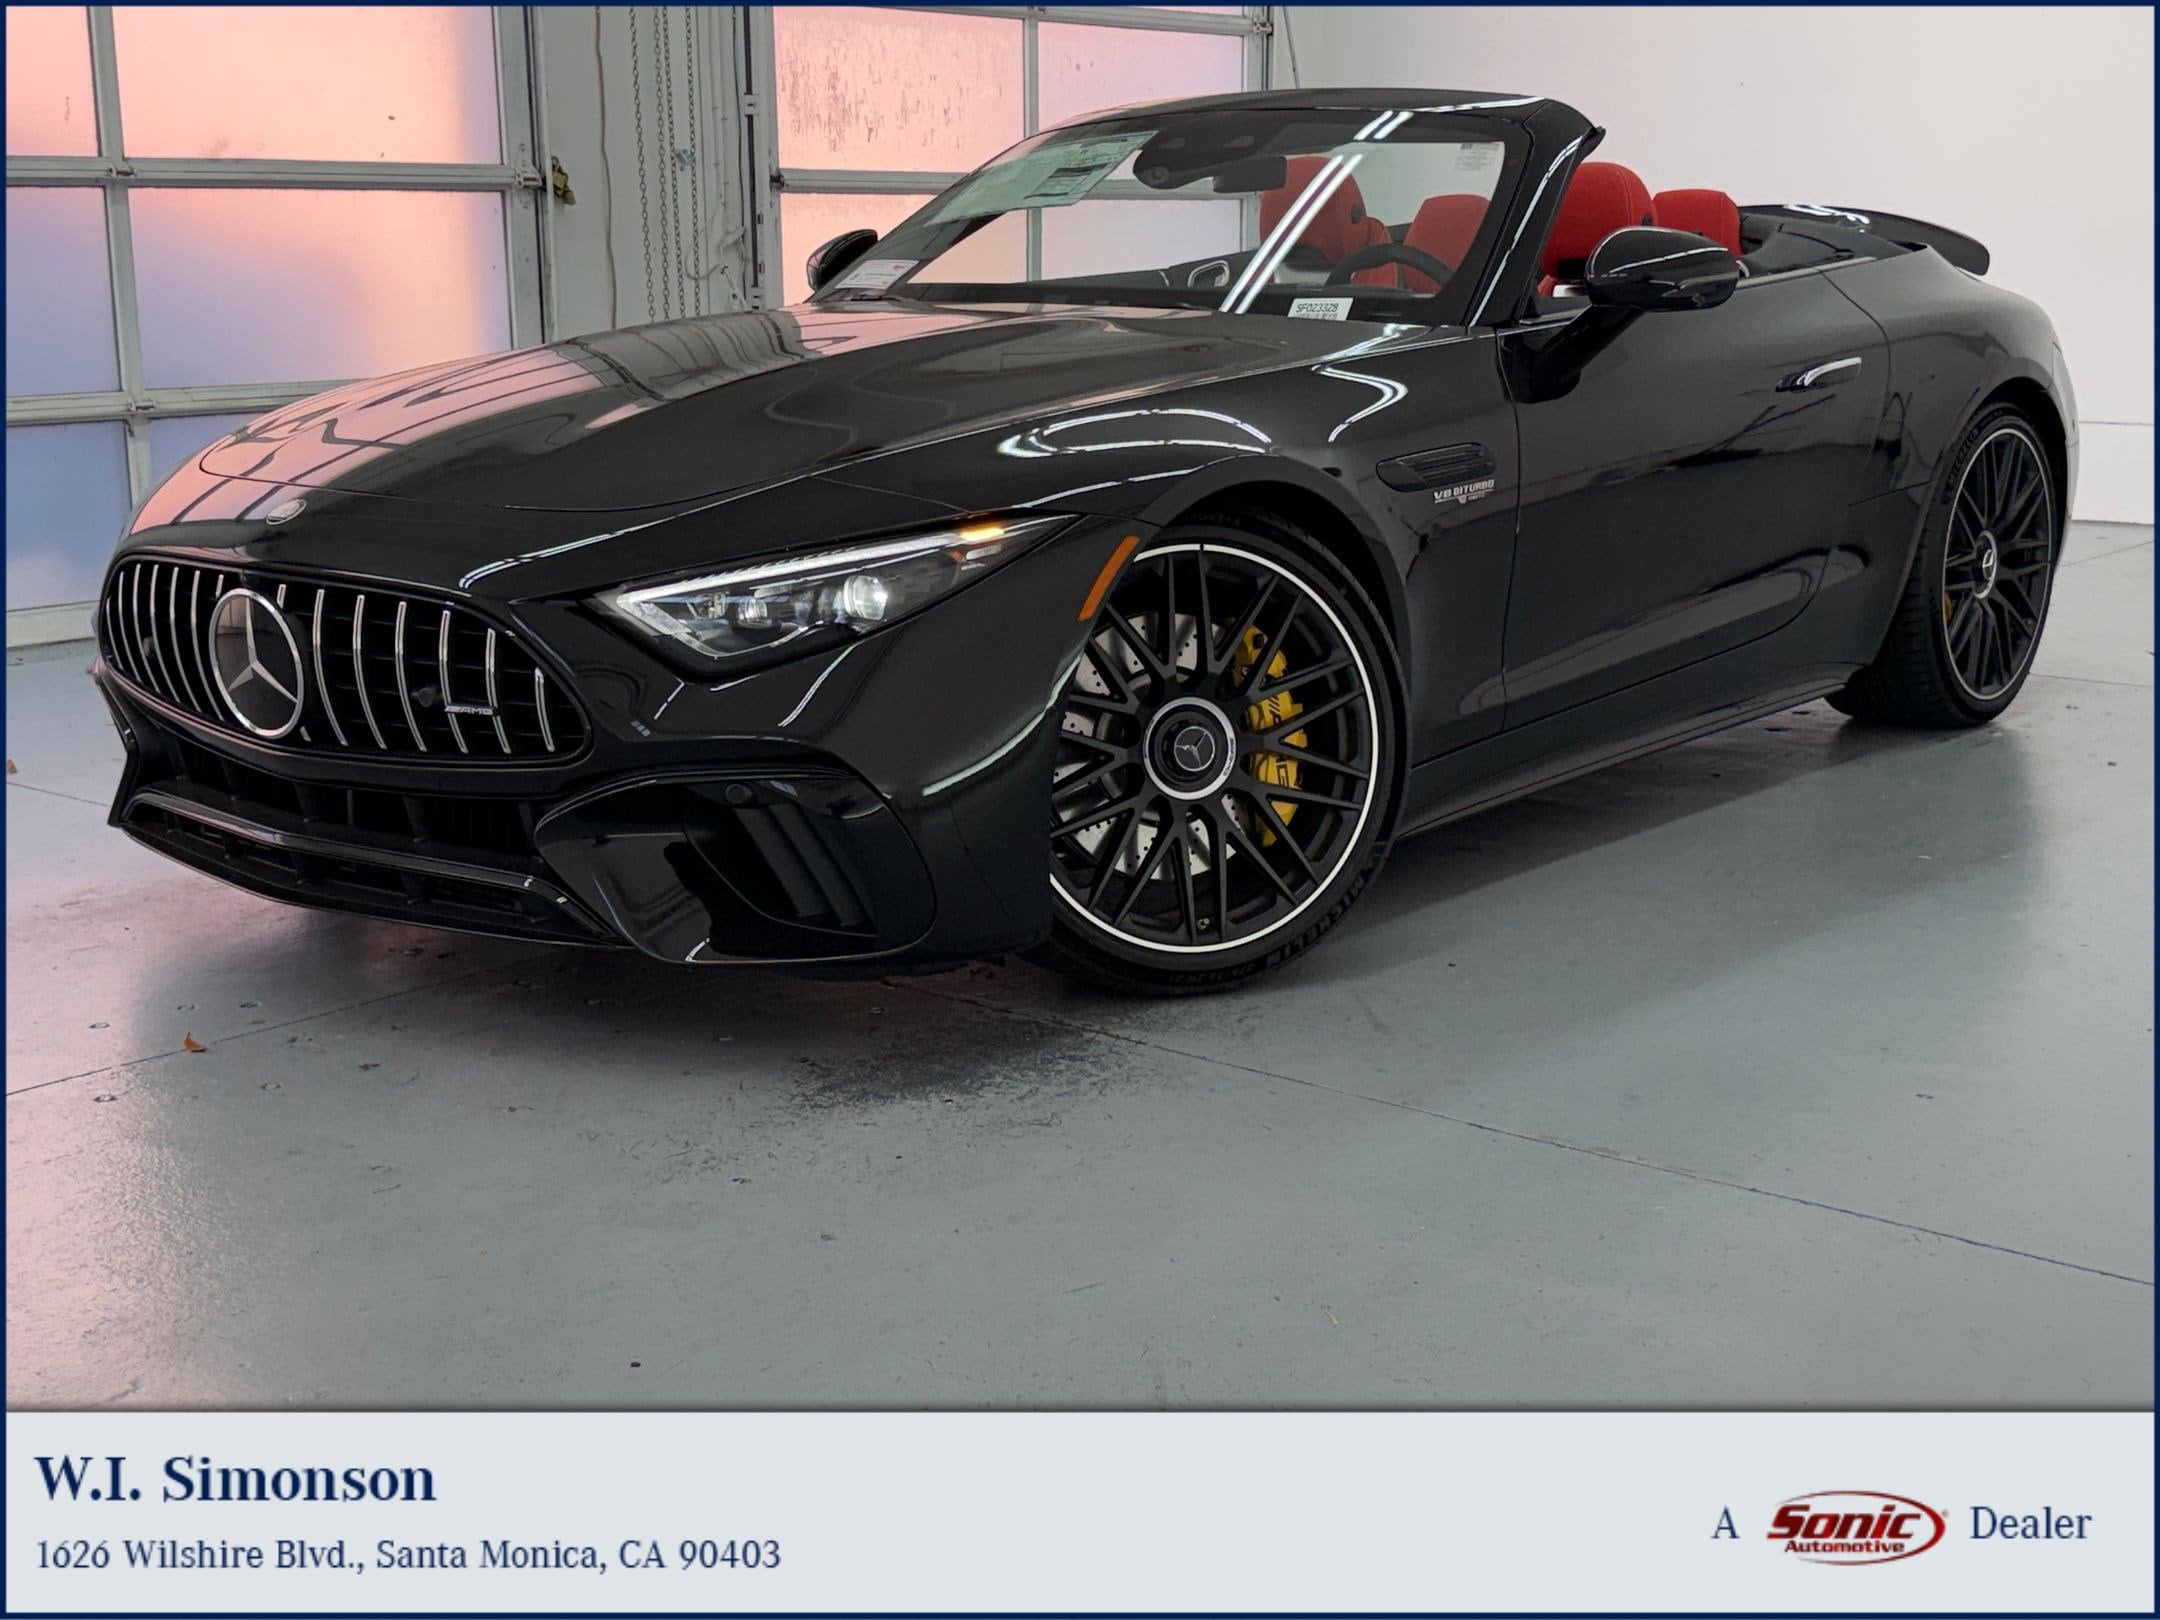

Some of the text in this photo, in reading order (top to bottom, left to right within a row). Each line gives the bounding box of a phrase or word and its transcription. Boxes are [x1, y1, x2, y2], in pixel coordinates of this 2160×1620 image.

[1434, 488, 1452, 499] V8
[1453, 479, 1495, 496] BITURBO
[1265, 872, 1369, 968] MICHELIN
